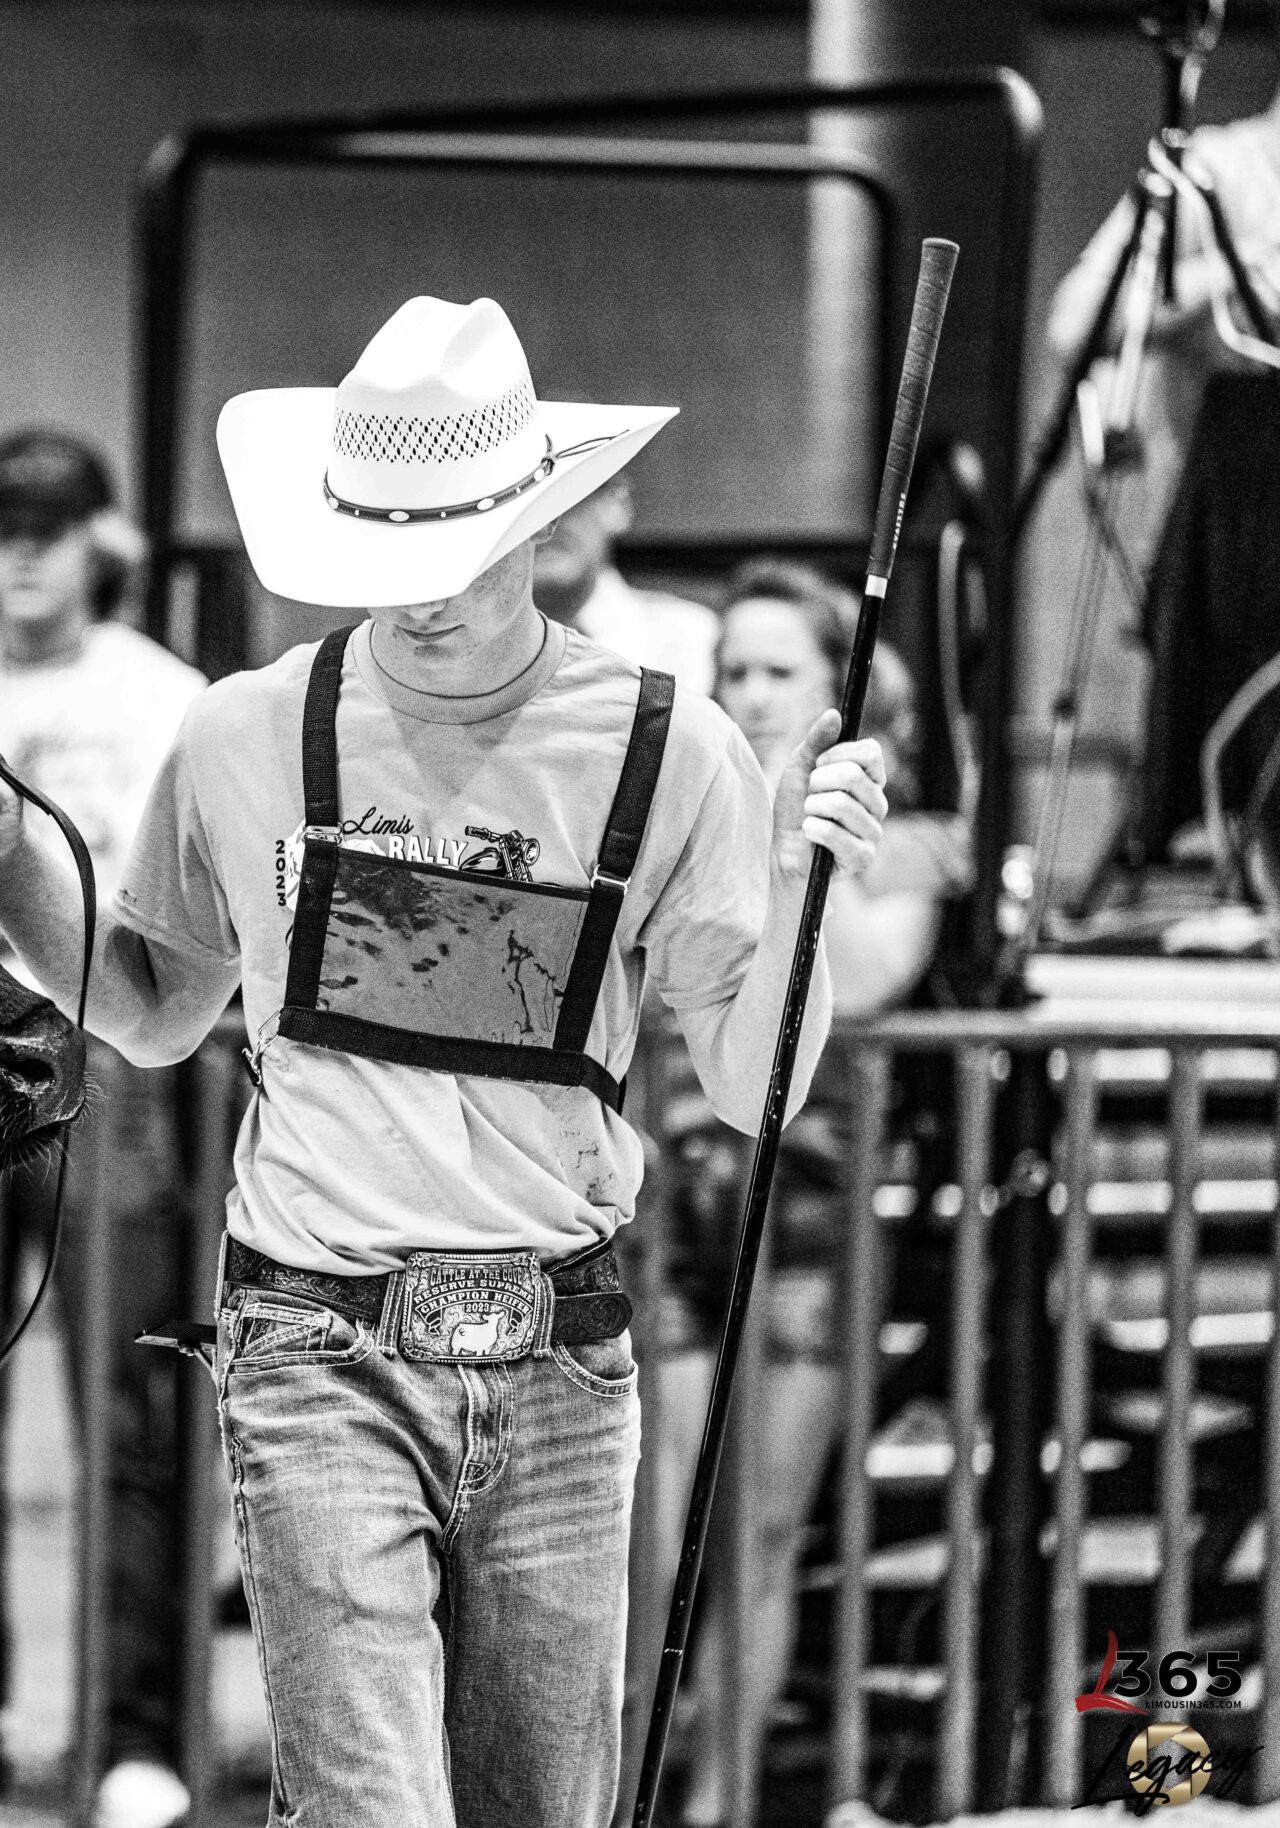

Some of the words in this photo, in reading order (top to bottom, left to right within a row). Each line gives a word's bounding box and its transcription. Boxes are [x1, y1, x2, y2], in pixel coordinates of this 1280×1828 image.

[342, 807, 414, 835] Limis
[388, 834, 468, 867] RALLY
[275, 839, 287, 907] 2023
[430, 1268, 466, 1286] CATTLE
[468, 1268, 481, 1279] AT
[483, 1268, 500, 1280] THE
[502, 1268, 523, 1285] COVE
[413, 1280, 475, 1305] RESERVE
[479, 1279, 535, 1303] SUPREME
[420, 1291, 489, 1314] CHAMPION
[494, 1292, 531, 1315] HEIFER
[465, 1302, 490, 1314] 2023
